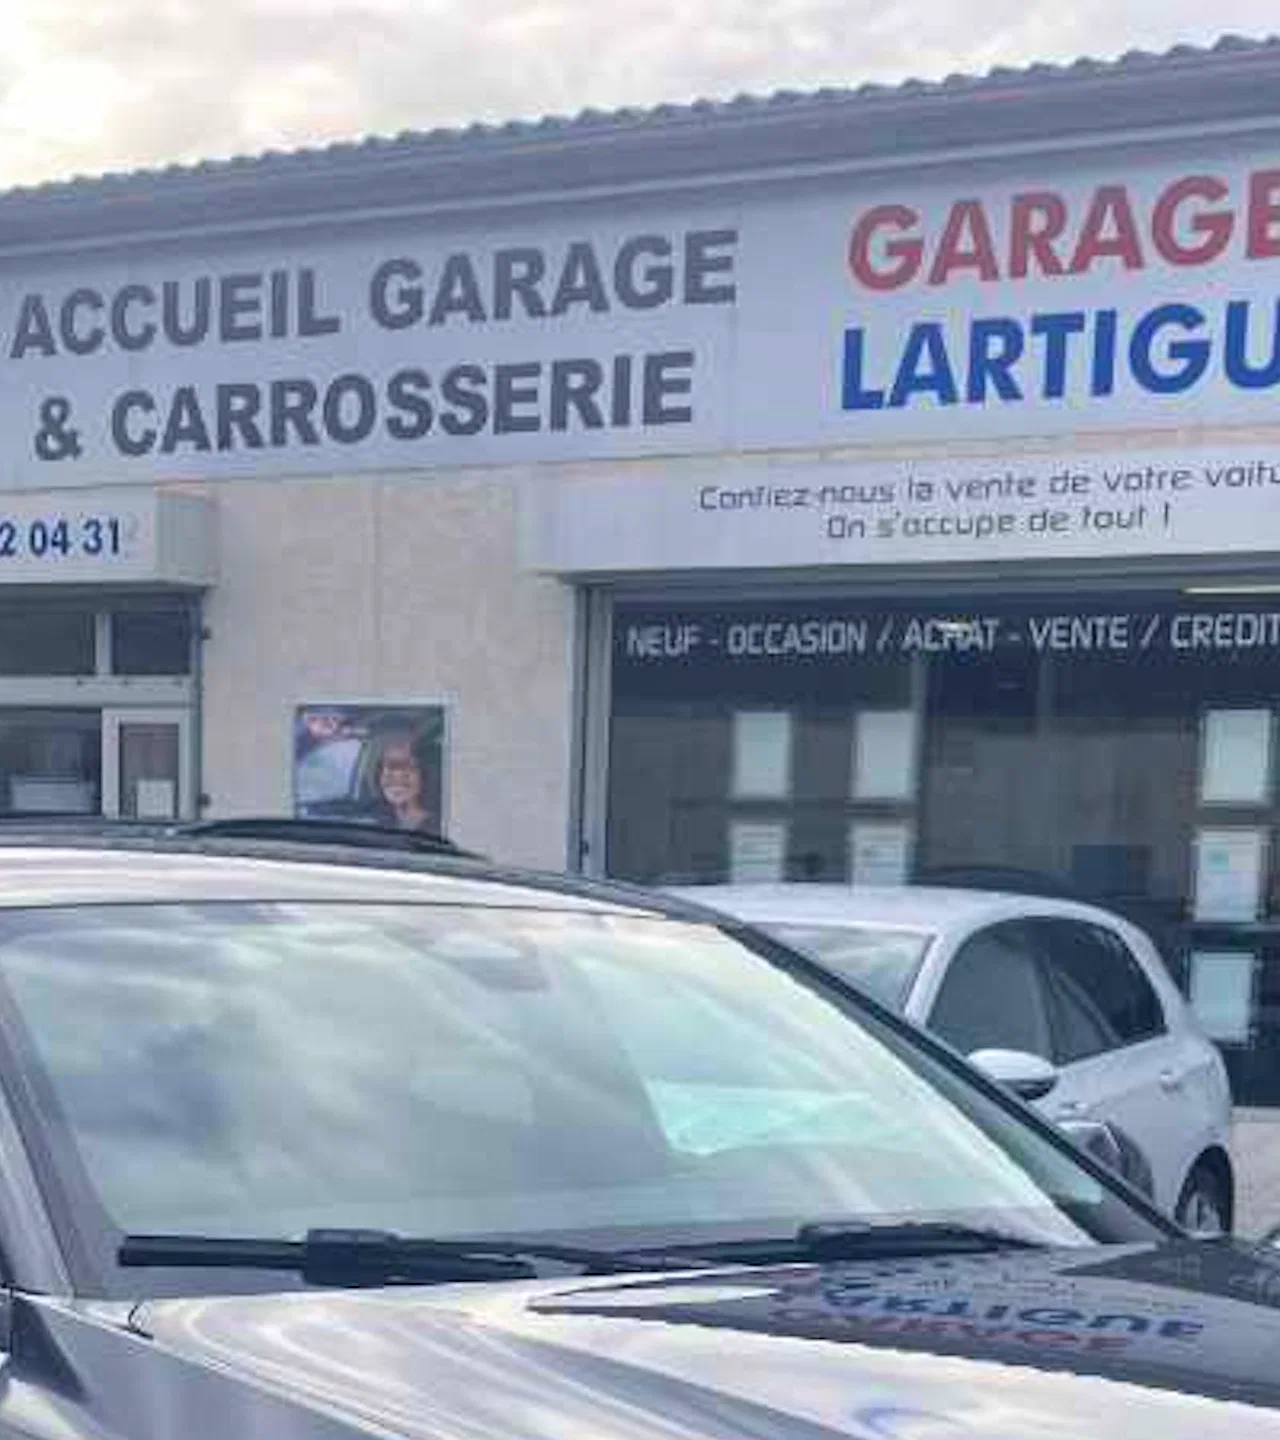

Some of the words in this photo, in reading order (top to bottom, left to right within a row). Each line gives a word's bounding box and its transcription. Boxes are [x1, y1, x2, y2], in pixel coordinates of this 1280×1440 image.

[9, 269, 340, 358] ACCUEIL
[370, 229, 738, 330] GARAGE
[34, 396, 83, 461] &
[111, 351, 694, 455] CARROSSERIE
[909, 475, 934, 501] la
[946, 475, 1037, 501] vente
[1050, 470, 1091, 494] de
[1104, 466, 1193, 492] votre
[29, 519, 71, 556] 04
[83, 517, 120, 555] 31
[827, 514, 865, 538] On
[876, 509, 1018, 538] s'occupe
[1030, 508, 1068, 532] de
[1082, 505, 1146, 530] tout
[627, 622, 699, 657] NEUF
[728, 619, 867, 655] OCCASION
[902, 616, 1000, 651] ACHAT
[1029, 615, 1128, 649] VENTE
